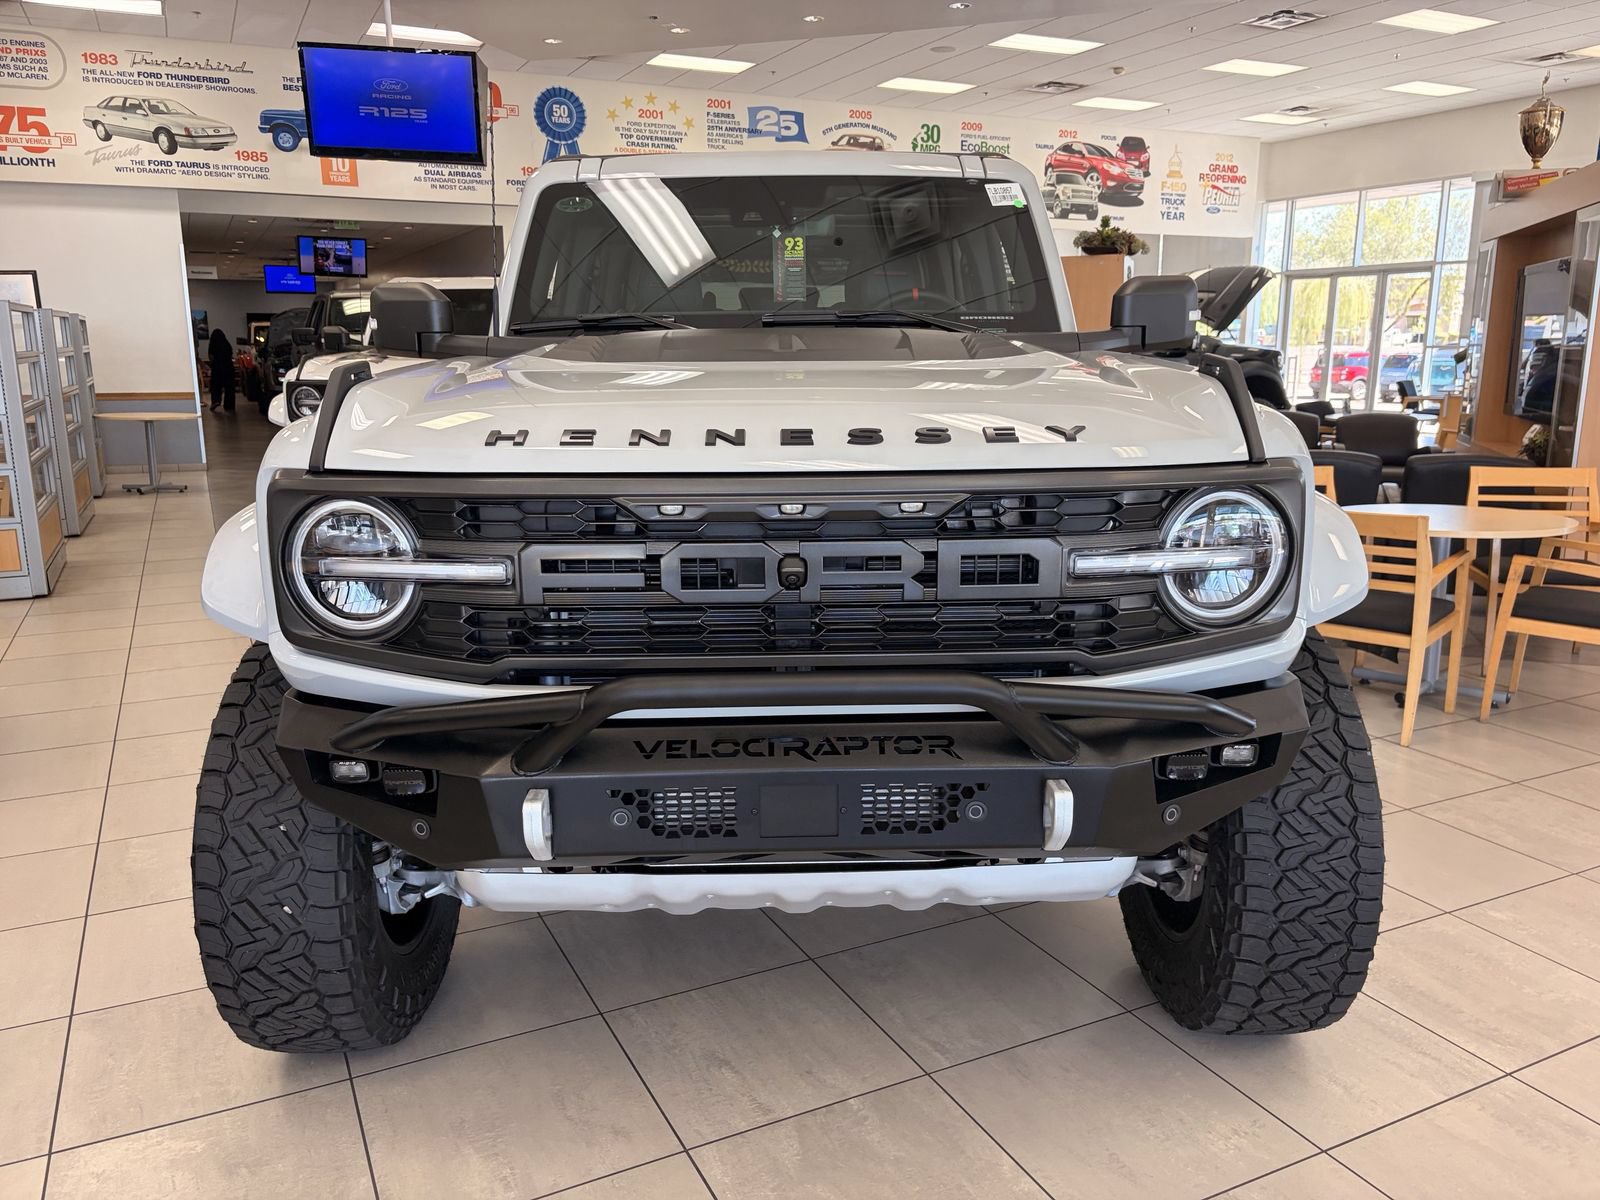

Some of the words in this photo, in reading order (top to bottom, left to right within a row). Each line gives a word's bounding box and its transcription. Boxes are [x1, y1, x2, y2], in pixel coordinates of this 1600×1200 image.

[10, 39, 46, 48] ENGINES
[15, 48, 47, 57] PRIXS
[81, 52, 118, 66] 1983
[124, 50, 254, 74] Thunderbird
[13, 64, 36, 72] SUCH
[7, 72, 50, 80] MCLAREN.
[99, 70, 134, 78] ALL-NEW
[137, 71, 162, 80] FORD
[164, 73, 230, 85] THUNDERBIRD
[92, 77, 144, 86] INTRODUCED
[155, 81, 204, 90] DEALERSHIP
[205, 84, 258, 95] SHOWROOMS.
[380, 80, 401, 90] Ford
[706, 98, 731, 109] 2001
[552, 104, 569, 117] 50
[638, 108, 664, 120] 2001
[706, 111, 735, 120] F-SERIES
[848, 109, 872, 120] 2005
[551, 116, 571, 124] YEARS
[706, 118, 741, 126] CELEBRATES
[755, 109, 799, 136] 25
[0, 105, 51, 154] 75
[643, 122, 677, 130] EXPEDITION
[822, 126, 834, 136] 5TH
[833, 122, 871, 130] GENERATION
[871, 124, 898, 141] MUSTANG
[961, 121, 983, 131] 2009
[635, 134, 684, 143] GOVERNMENT
[920, 123, 941, 144] 30
[1058, 129, 1078, 139] 2012
[5, 136, 23, 144] BUILT
[25, 138, 53, 146] VEHICLE
[62, 135, 73, 144] 69
[960, 140, 1011, 154] EcoBoost
[84, 143, 143, 166] Taurus
[234, 150, 269, 163] 1985
[1215, 152, 1234, 162] 2012
[174, 161, 211, 169] TAURUS
[221, 164, 270, 173] INTRODUCED
[418, 162, 459, 170] AUTOMAKER
[1208, 163, 1239, 174] GRAND
[136, 167, 177, 175] DRAMATIC
[237, 172, 271, 181] STYLING.
[329, 175, 351, 183] YEARS
[424, 169, 446, 177] DUAL
[447, 170, 482, 178] AIRBAGS
[1198, 173, 1247, 184] REOPENING
[423, 176, 457, 184] STANDARD
[457, 178, 494, 186] EQUIPMENT
[1160, 181, 1187, 192] F-150
[1160, 198, 1185, 206] TRUCK
[1160, 210, 1185, 220] YEAR
[784, 237, 804, 250] 93
[484, 424, 1087, 448] HENNESSEY
[520, 537, 1063, 602] FORD
[633, 735, 964, 763] VELOCIRAPTOR
